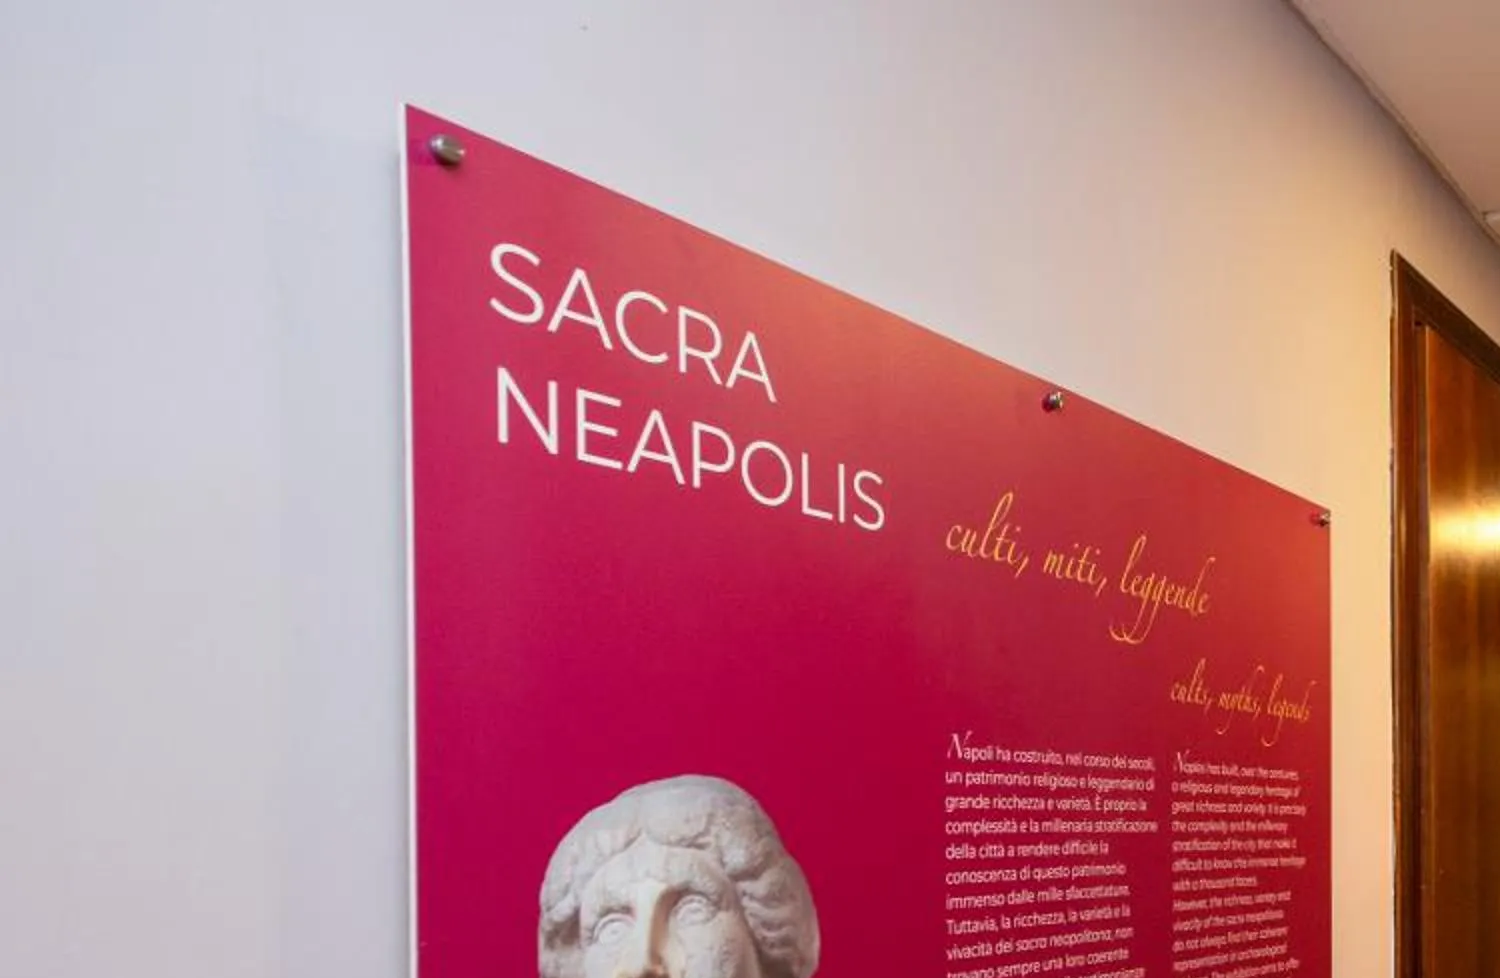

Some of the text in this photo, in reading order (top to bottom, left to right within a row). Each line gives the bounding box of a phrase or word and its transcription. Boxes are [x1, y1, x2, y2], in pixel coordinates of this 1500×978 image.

[489, 243, 777, 403] SACRA
[497, 366, 885, 531] NEAPOLIS
[945, 492, 1215, 644] culti, miti, leggende
[946, 730, 994, 762] Napoli
[945, 773, 963, 784] un
[945, 795, 990, 813] grande
[944, 820, 1018, 838] complessità
[945, 844, 976, 859] della
[945, 870, 1017, 885] conoscenza
[945, 896, 1004, 911] immenso
[946, 942, 993, 962] vivacità
